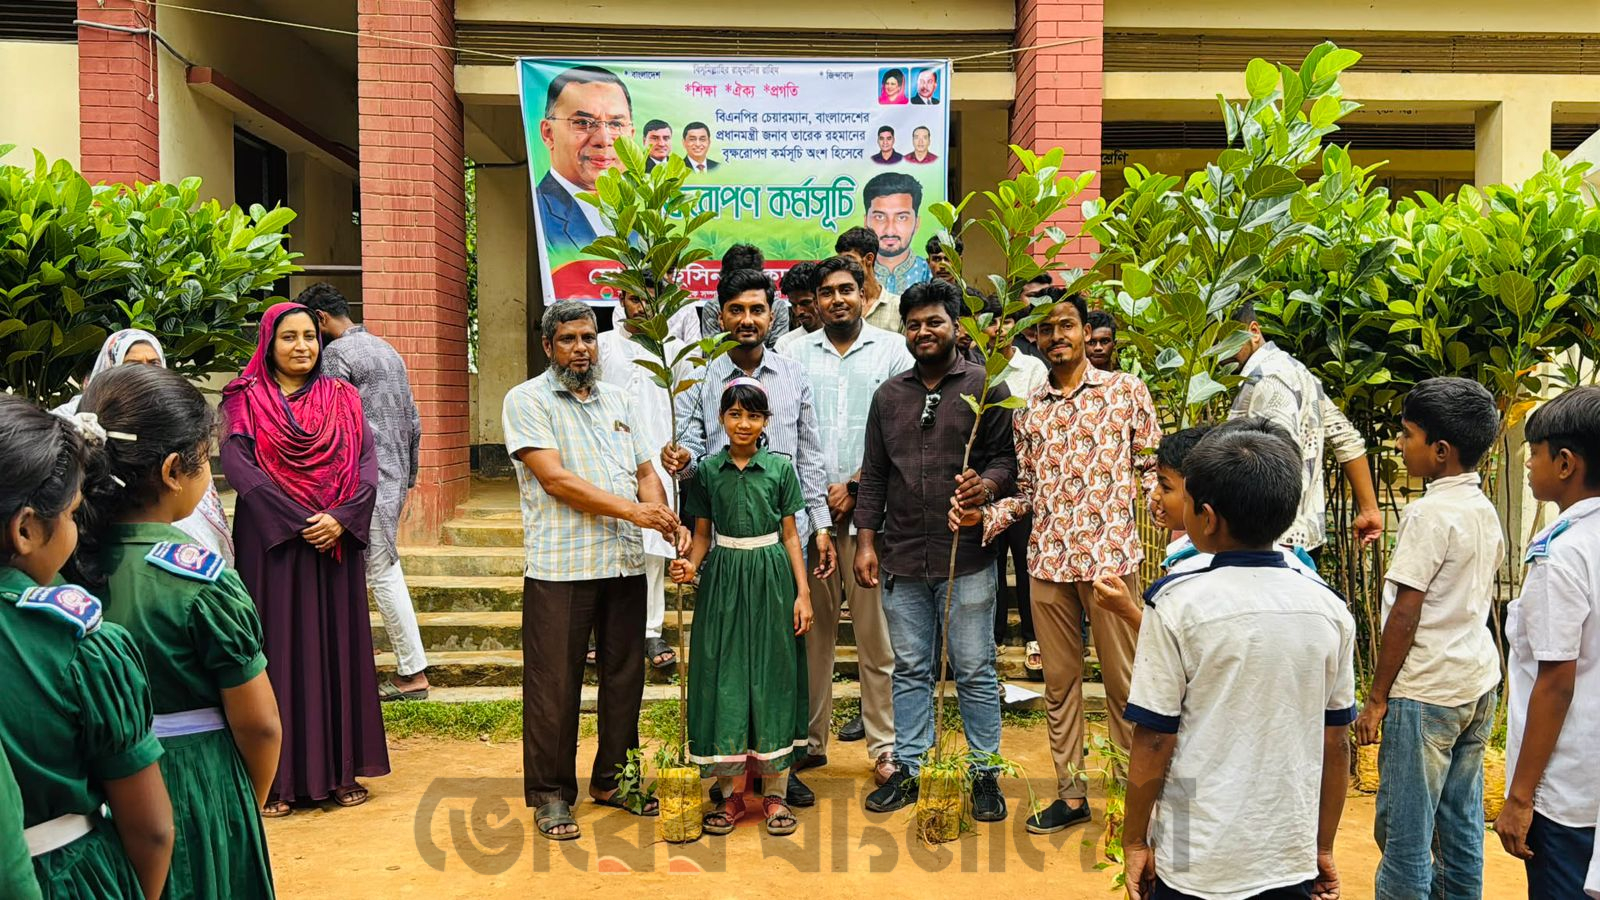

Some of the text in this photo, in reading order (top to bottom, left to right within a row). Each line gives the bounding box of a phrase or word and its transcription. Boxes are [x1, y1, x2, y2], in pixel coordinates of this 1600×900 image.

[715, 109, 870, 125] বিএনপির চেয়ারম্যান, বাংলাদেশের
[716, 126, 866, 142] প্রধানমন্ত্রী জনাব তারেক রহমানের
[722, 144, 864, 164] বৃক্ষরোপণ কর্মসূচি অংশ হিসেবে
[766, 176, 857, 230] কর্মসূচি
